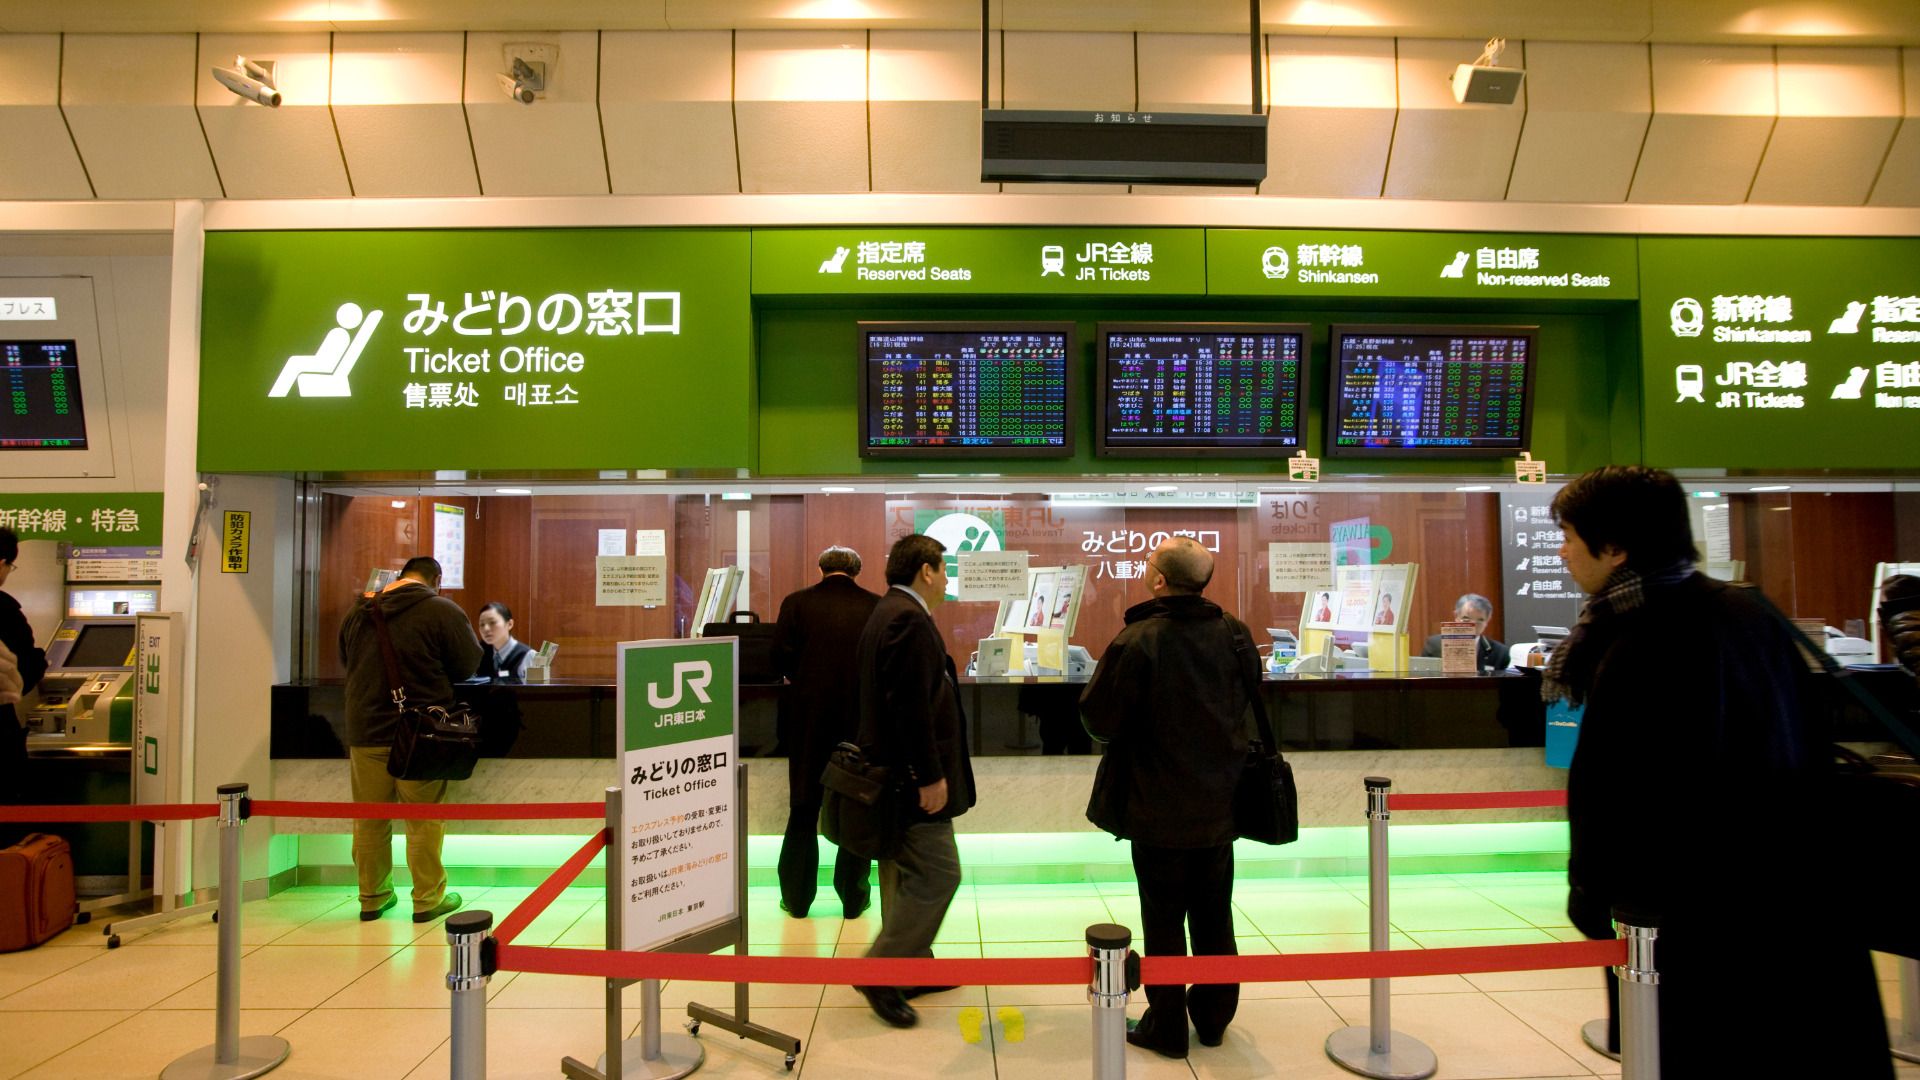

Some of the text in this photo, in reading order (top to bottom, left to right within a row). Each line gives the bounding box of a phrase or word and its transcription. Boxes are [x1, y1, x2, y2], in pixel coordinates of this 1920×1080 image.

[1094, 112, 1153, 124] お知らせ
[857, 241, 926, 265] 指定席
[1076, 242, 1153, 265] JR全線
[1297, 244, 1364, 268] 新幹線
[1476, 247, 1539, 270] 自由席
[857, 267, 972, 281] Reserved Seats
[1076, 267, 1151, 281] JR Tickets
[1298, 270, 1378, 284] Shinkansen
[1477, 272, 1611, 288] Non-reserved Seats
[403, 289, 681, 336] みどりの窓口
[1711, 294, 1794, 323] 新幹線
[1713, 326, 1812, 343] Shinkansen
[403, 346, 585, 374] Ticket Office
[1715, 360, 1808, 388] JR全線
[402, 382, 580, 409] 售票处 매표소
[1715, 392, 1805, 409] JR Tickets
[228, 513, 244, 571] 防犯カメラ作動中
[648, 660, 713, 709] JR
[144, 653, 160, 775] 出口
[654, 709, 706, 729] JR東日本
[630, 751, 728, 786] みどりの窓口
[643, 777, 717, 802] Ticket Office
